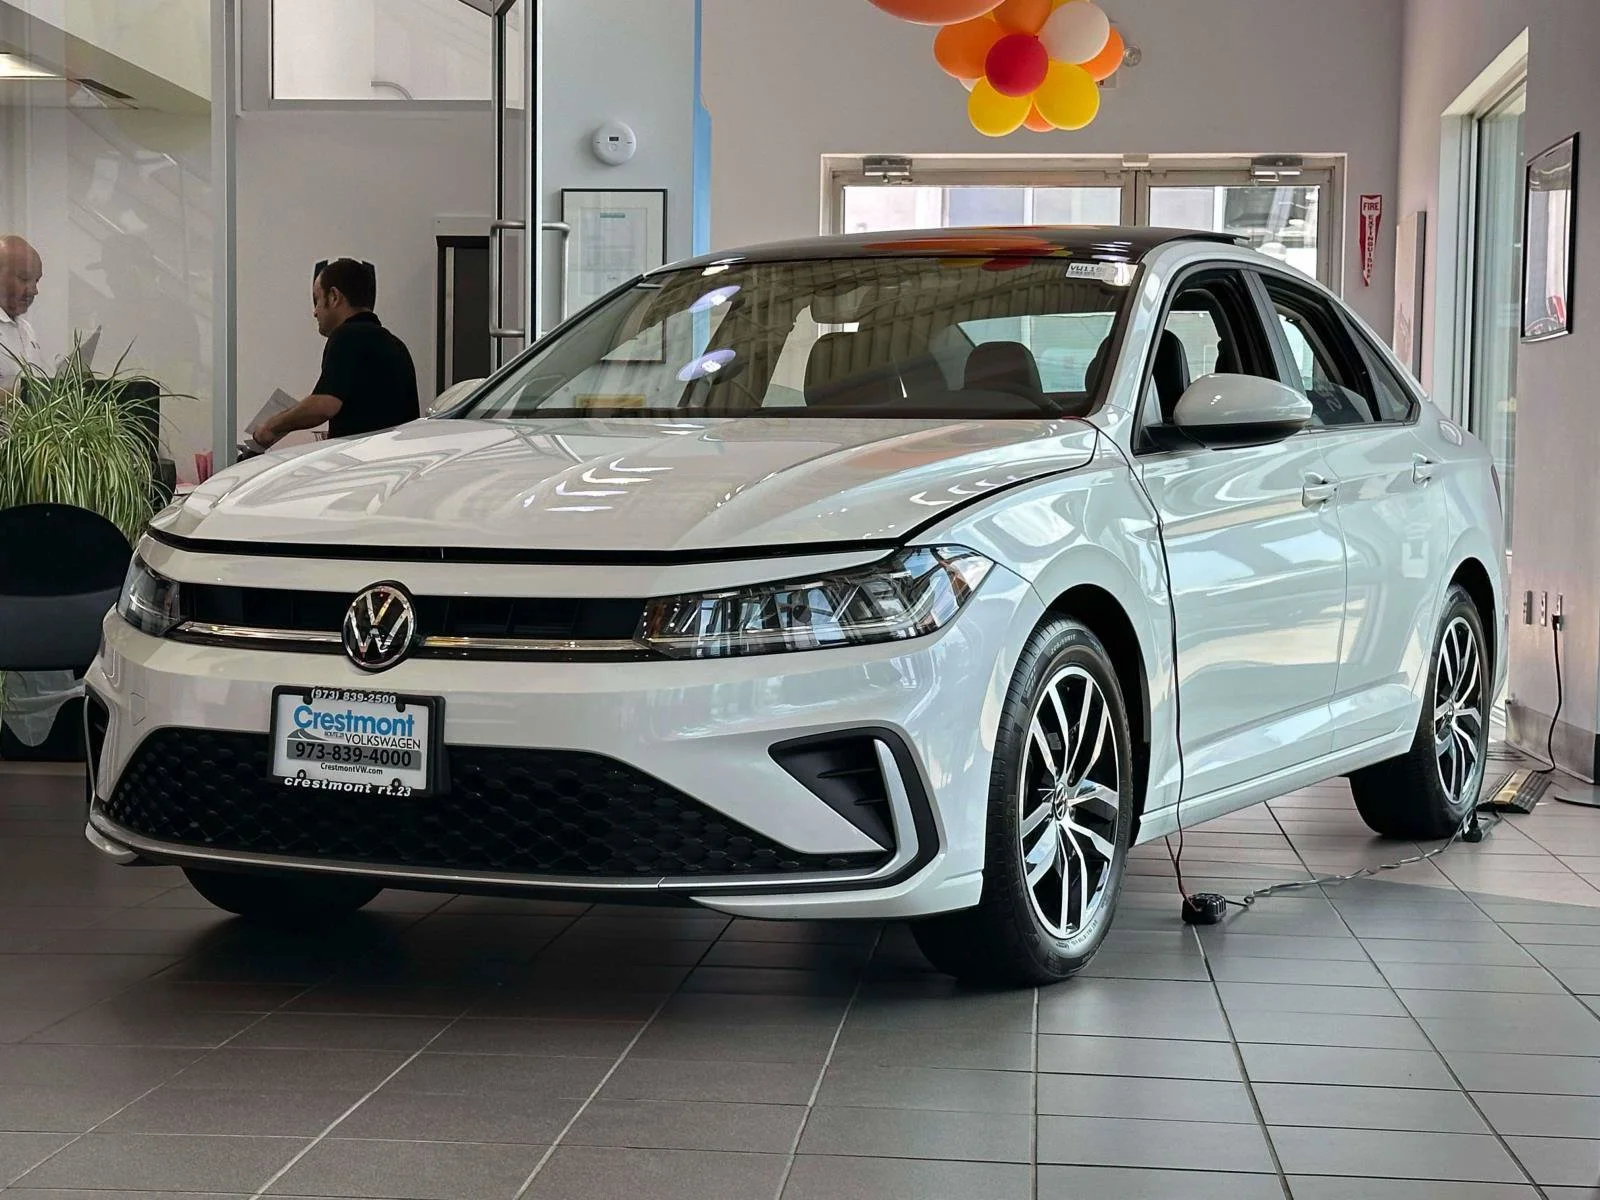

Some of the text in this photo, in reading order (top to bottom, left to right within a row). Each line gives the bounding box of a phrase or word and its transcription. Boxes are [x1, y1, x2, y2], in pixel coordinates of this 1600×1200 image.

[1363, 202, 1379, 211] FIRE
[311, 688, 397, 705] (973) 839-2500
[293, 705, 415, 737] Crestmont
[344, 732, 421, 749] VOLKSWAGEN
[295, 742, 412, 767] 973-839-4000
[320, 762, 383, 775] CrestmontVW.com
[284, 776, 412, 797] crestmont rt.23
